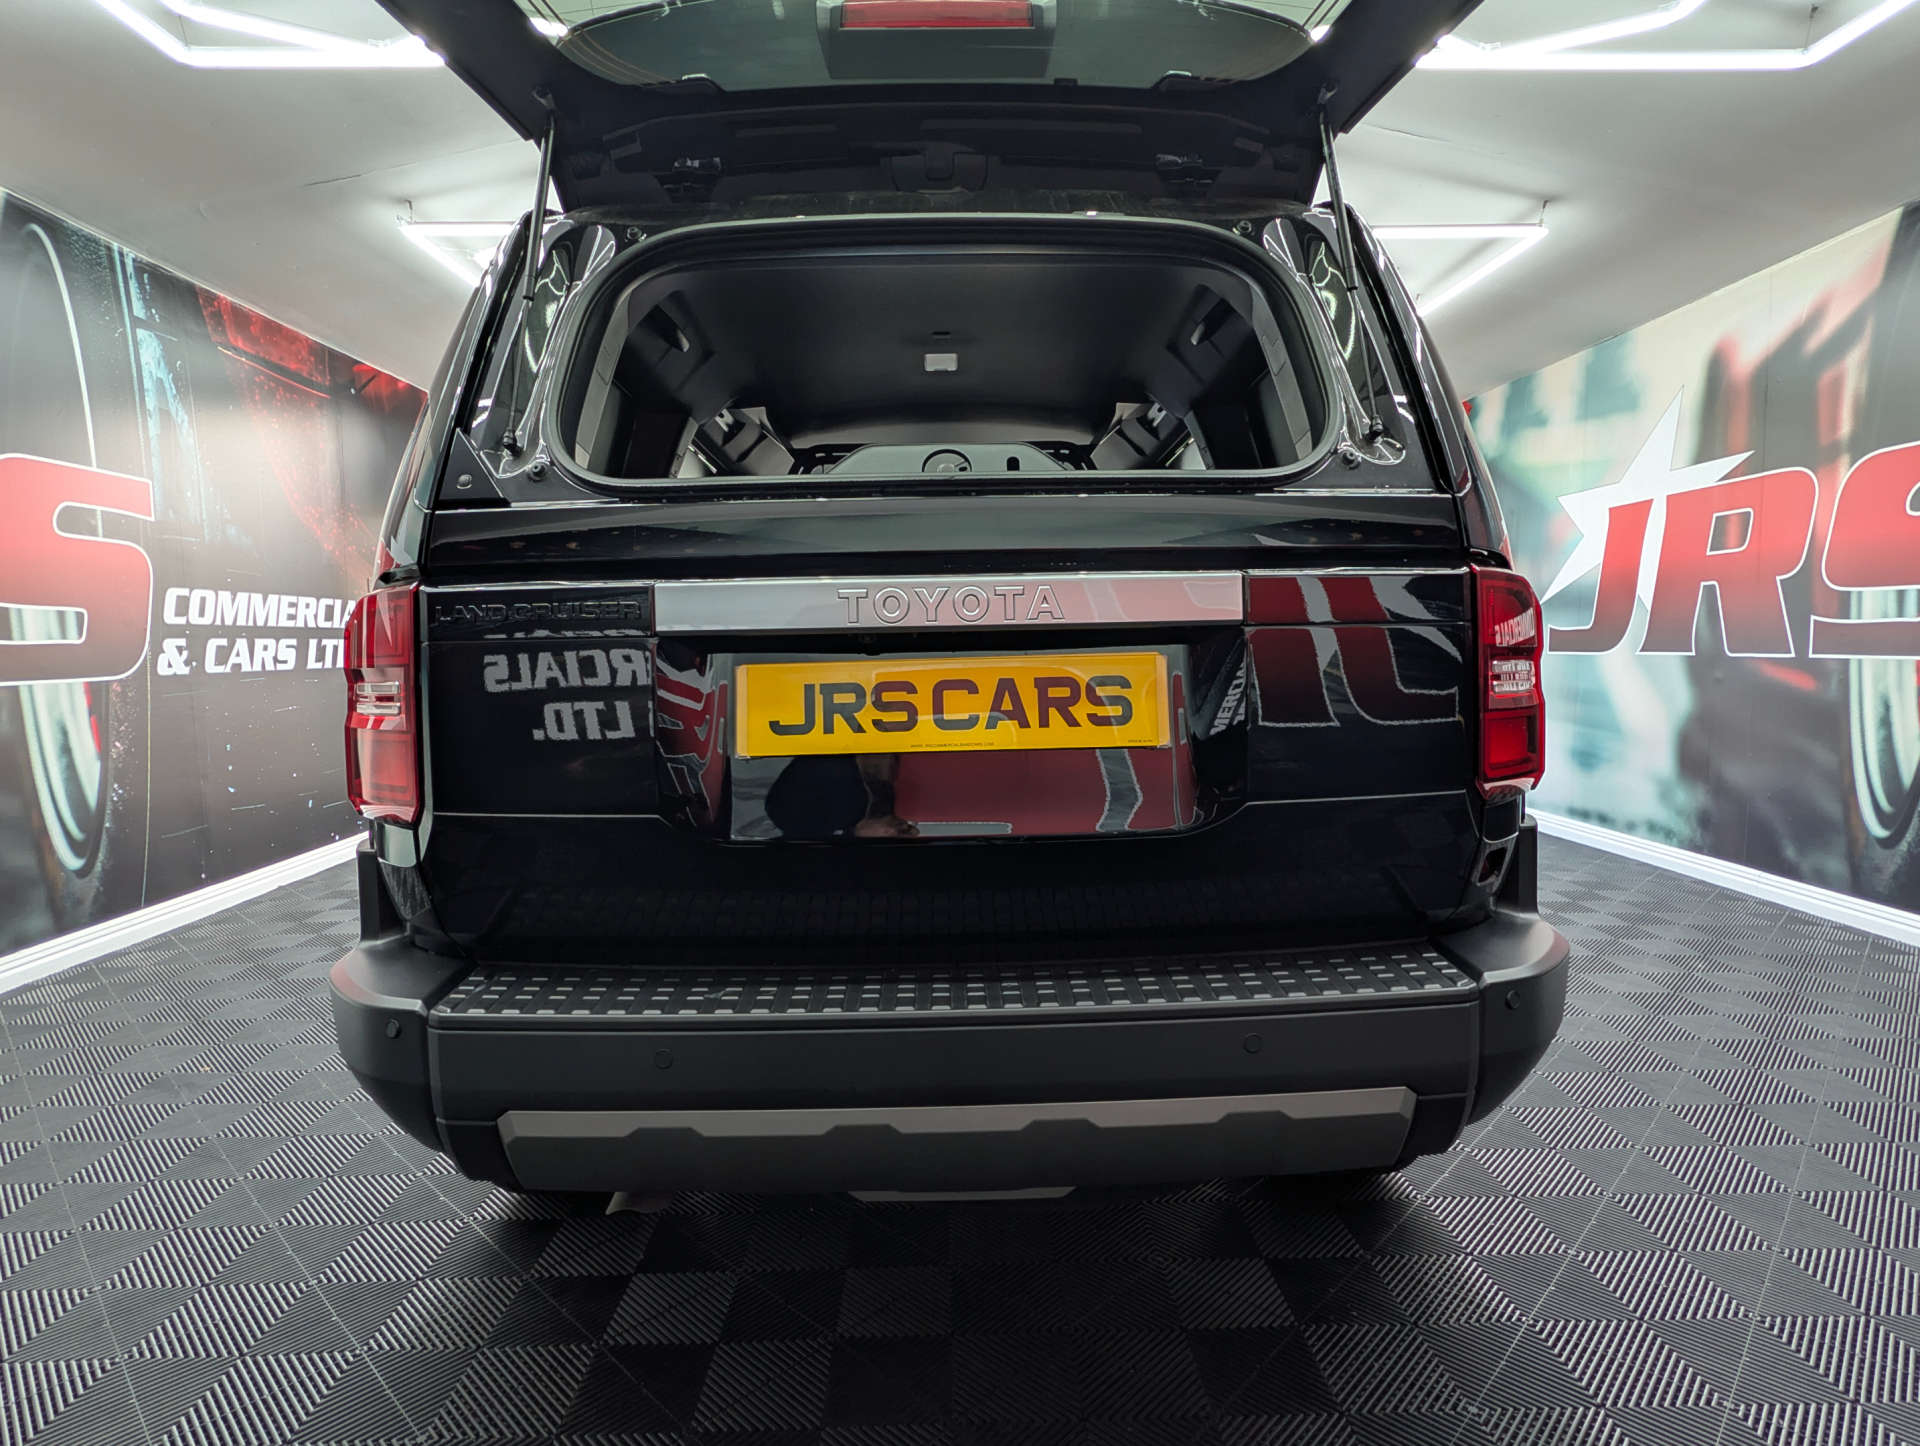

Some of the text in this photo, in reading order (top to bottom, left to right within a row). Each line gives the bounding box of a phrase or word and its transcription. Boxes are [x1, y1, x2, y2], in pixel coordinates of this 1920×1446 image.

[434, 601, 642, 622] LAND CRUISER
[837, 585, 1066, 625] TOYOTA
[157, 638, 190, 676] &
[204, 637, 298, 674] CARS
